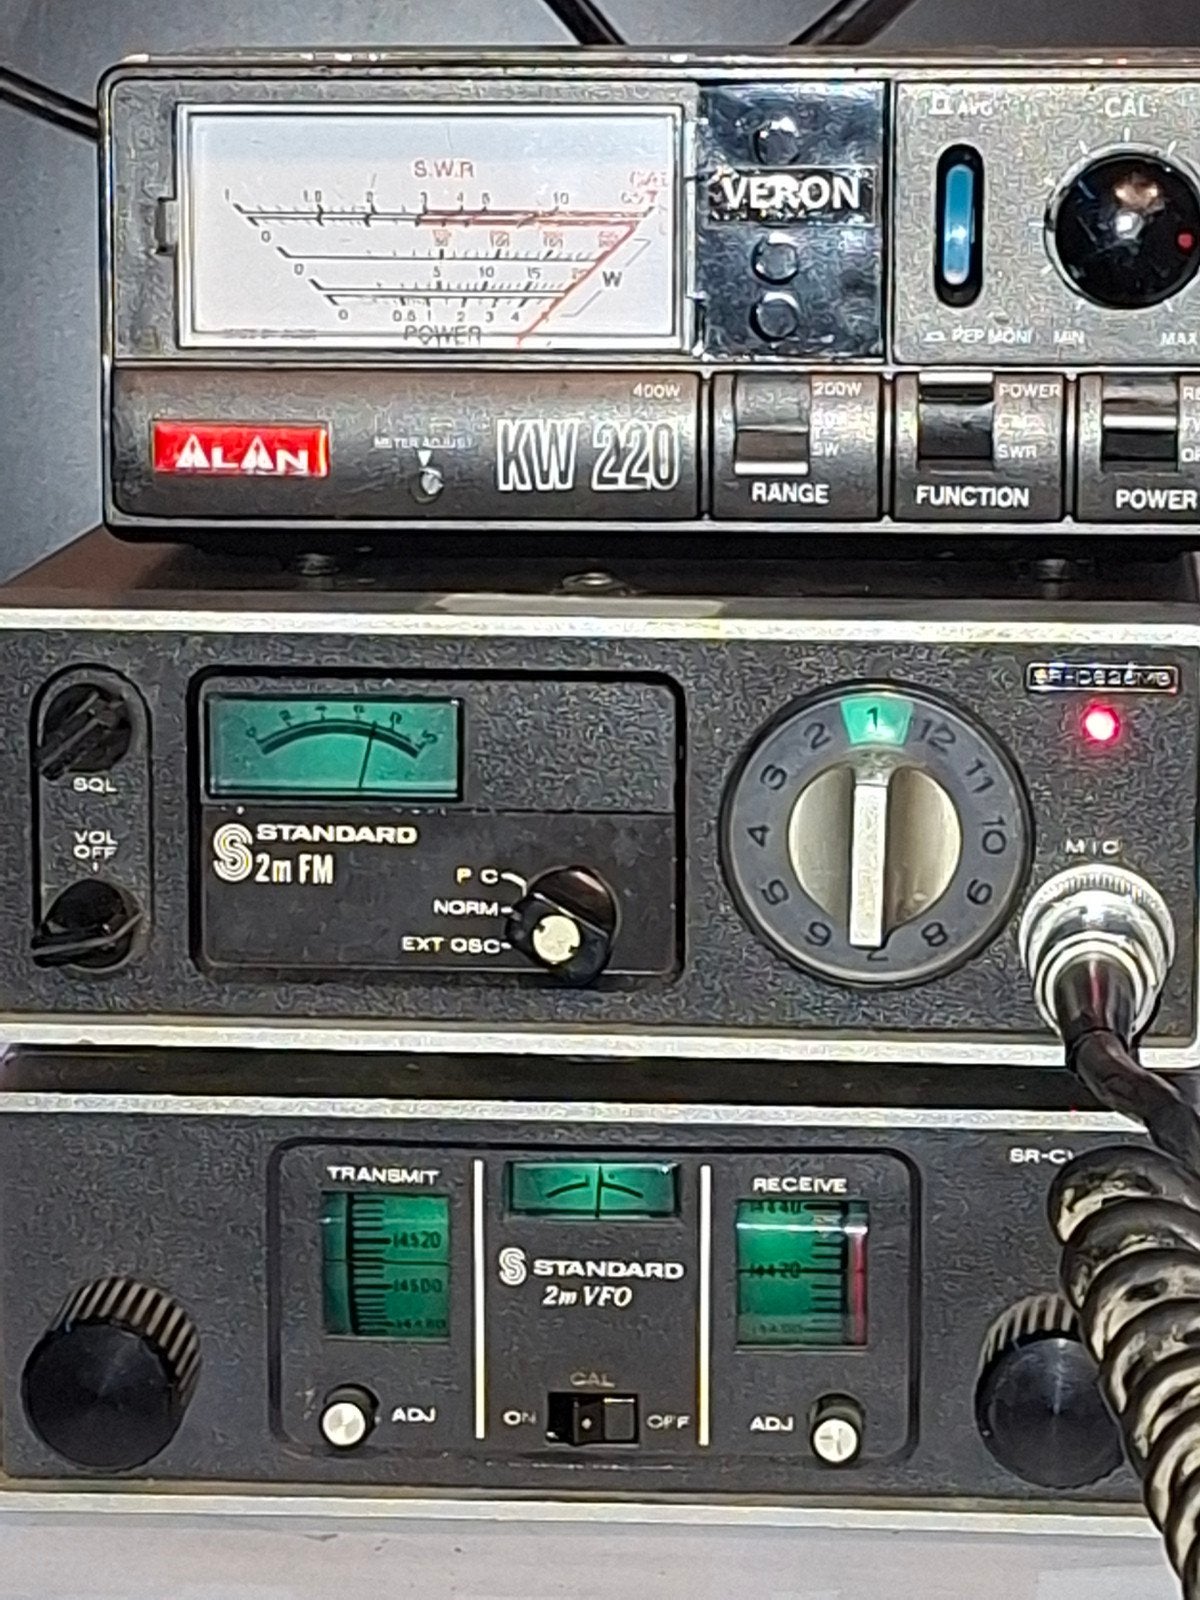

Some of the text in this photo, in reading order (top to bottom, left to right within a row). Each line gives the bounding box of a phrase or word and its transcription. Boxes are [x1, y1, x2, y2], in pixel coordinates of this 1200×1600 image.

[1105, 97, 1150, 118] CAL
[722, 176, 860, 209] VERON
[479, 266, 495, 278] 10
[601, 270, 622, 288] W
[457, 311, 466, 322] 2
[485, 311, 494, 323] 3
[510, 312, 521, 322] 4
[633, 382, 682, 399] 400W
[813, 381, 863, 398] 200W
[1000, 382, 1063, 399] POWER
[174, 433, 310, 473] ALAN
[497, 417, 682, 493] KW 220
[999, 444, 1038, 459] SWR
[752, 481, 830, 506] RANGE
[916, 485, 1030, 509] FUNCTION
[1115, 488, 1198, 511] POWER
[867, 706, 879, 731] 1
[803, 722, 831, 750] 2
[918, 719, 957, 751] 12
[72, 777, 119, 794] SQL
[760, 764, 788, 791] 3
[965, 758, 996, 794] 11
[73, 830, 118, 846] VOL
[256, 823, 418, 845] STANDARD
[746, 823, 771, 848] 4
[981, 816, 1007, 856] 10
[73, 844, 118, 861] OFF
[1065, 839, 1120, 855] MIC
[254, 853, 334, 885] 2m FM
[433, 899, 499, 916] NORM
[921, 921, 949, 948] 8
[402, 937, 500, 953] EXT OSC
[1010, 1148, 1074, 1165] SR-C
[326, 1164, 441, 1185] TRANSMIT
[752, 1177, 848, 1194] RECEIVE
[533, 1259, 684, 1280] STANDARD
[542, 1284, 633, 1308] 2m VFO
[569, 1371, 616, 1389] CAL
[391, 1406, 437, 1423] ADJ
[502, 1410, 537, 1426] ON
[646, 1414, 691, 1429] OFF
[750, 1415, 794, 1431] ADJ
